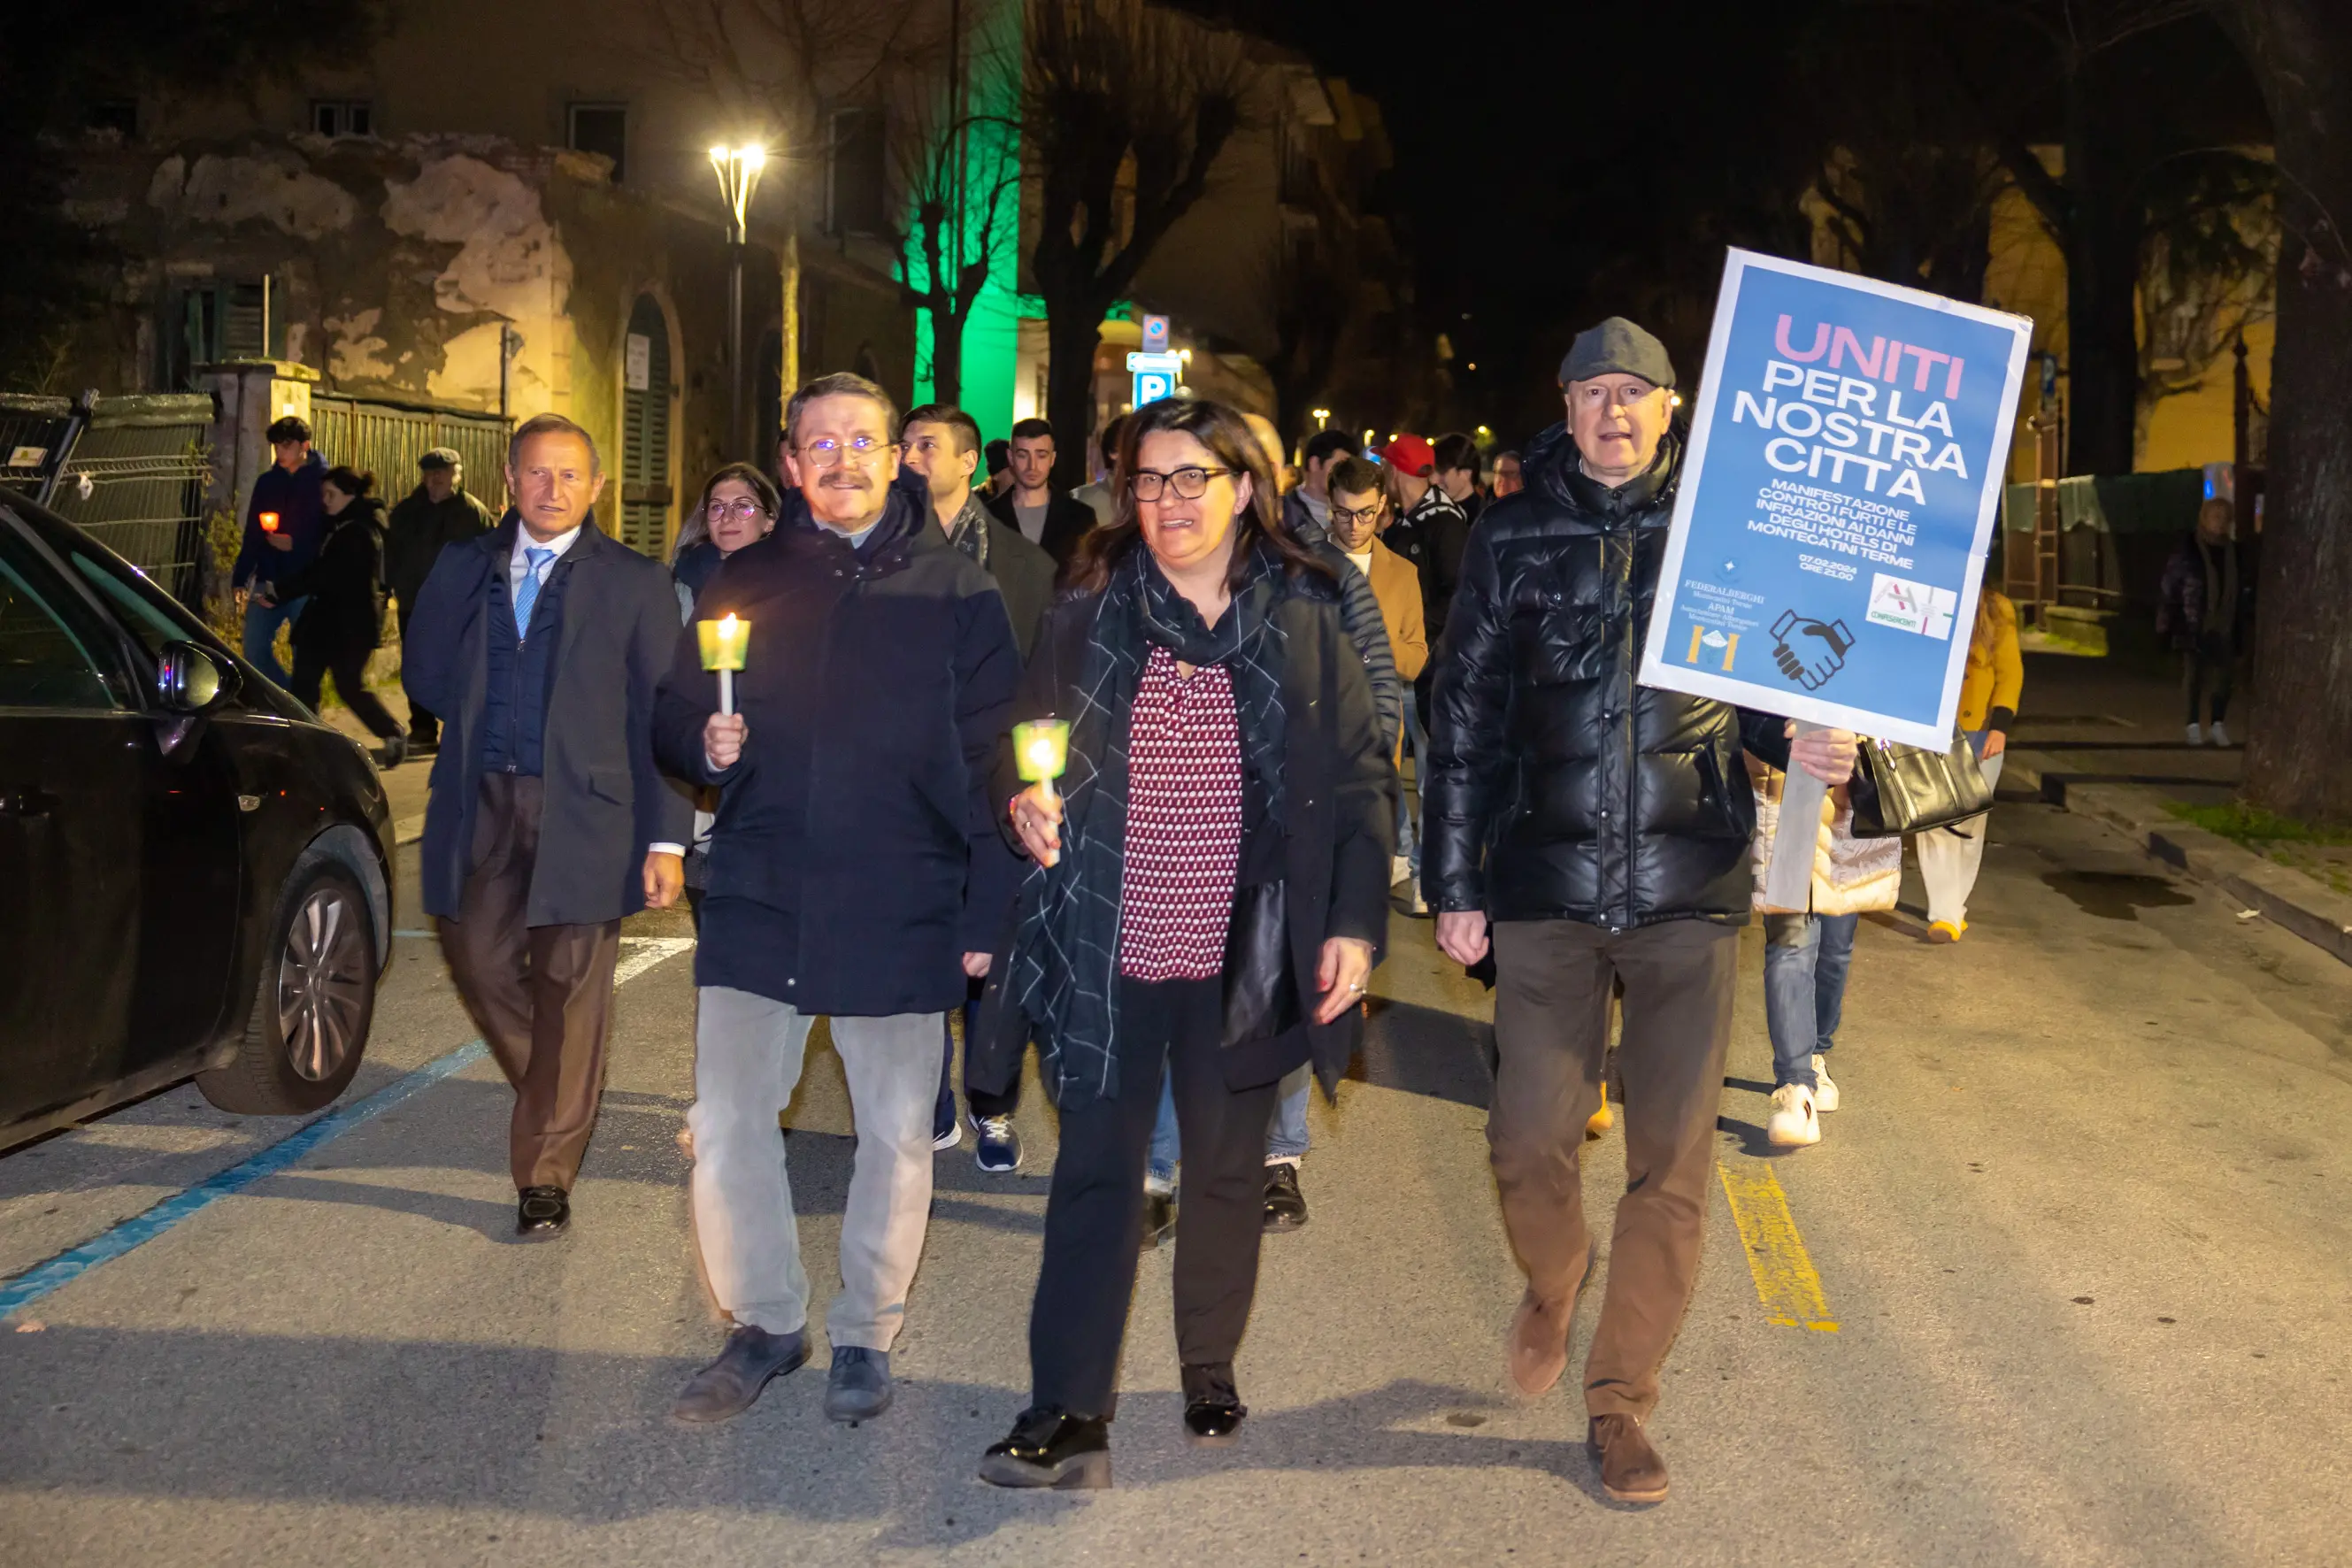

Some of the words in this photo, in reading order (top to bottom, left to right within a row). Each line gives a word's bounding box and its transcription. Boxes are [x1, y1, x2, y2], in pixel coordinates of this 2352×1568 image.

[1774, 314, 1964, 400] UNITI
[1763, 360, 1877, 417] PER
[1887, 390, 1954, 437] LA
[1732, 390, 1968, 480] NOSTRA
[1764, 437, 1925, 505] CITTÀ
[1756, 498, 1847, 528] INFRAZIONI
[1848, 521, 1864, 533] AI
[1865, 525, 1914, 546] DANNI
[1759, 488, 1831, 512] CONTRO
[1833, 504, 1839, 514] I
[1840, 506, 1885, 527] FURTI
[1886, 519, 1897, 530] E
[1898, 521, 1918, 535] LE
[1772, 479, 1910, 522] MANIFESTAZIONE
[1748, 520, 1858, 556] MONTECATINI
[1860, 547, 1914, 570] TERME
[1770, 512, 1817, 533] DEGLI
[1818, 525, 1879, 549] HOTELS
[1881, 541, 1898, 553] DI
[1799, 554, 1857, 574] 07.02.2024
[1800, 562, 1823, 574] ORE
[1685, 580, 1764, 604] FEDERALBERGHI
[1708, 602, 1734, 613] APAM
